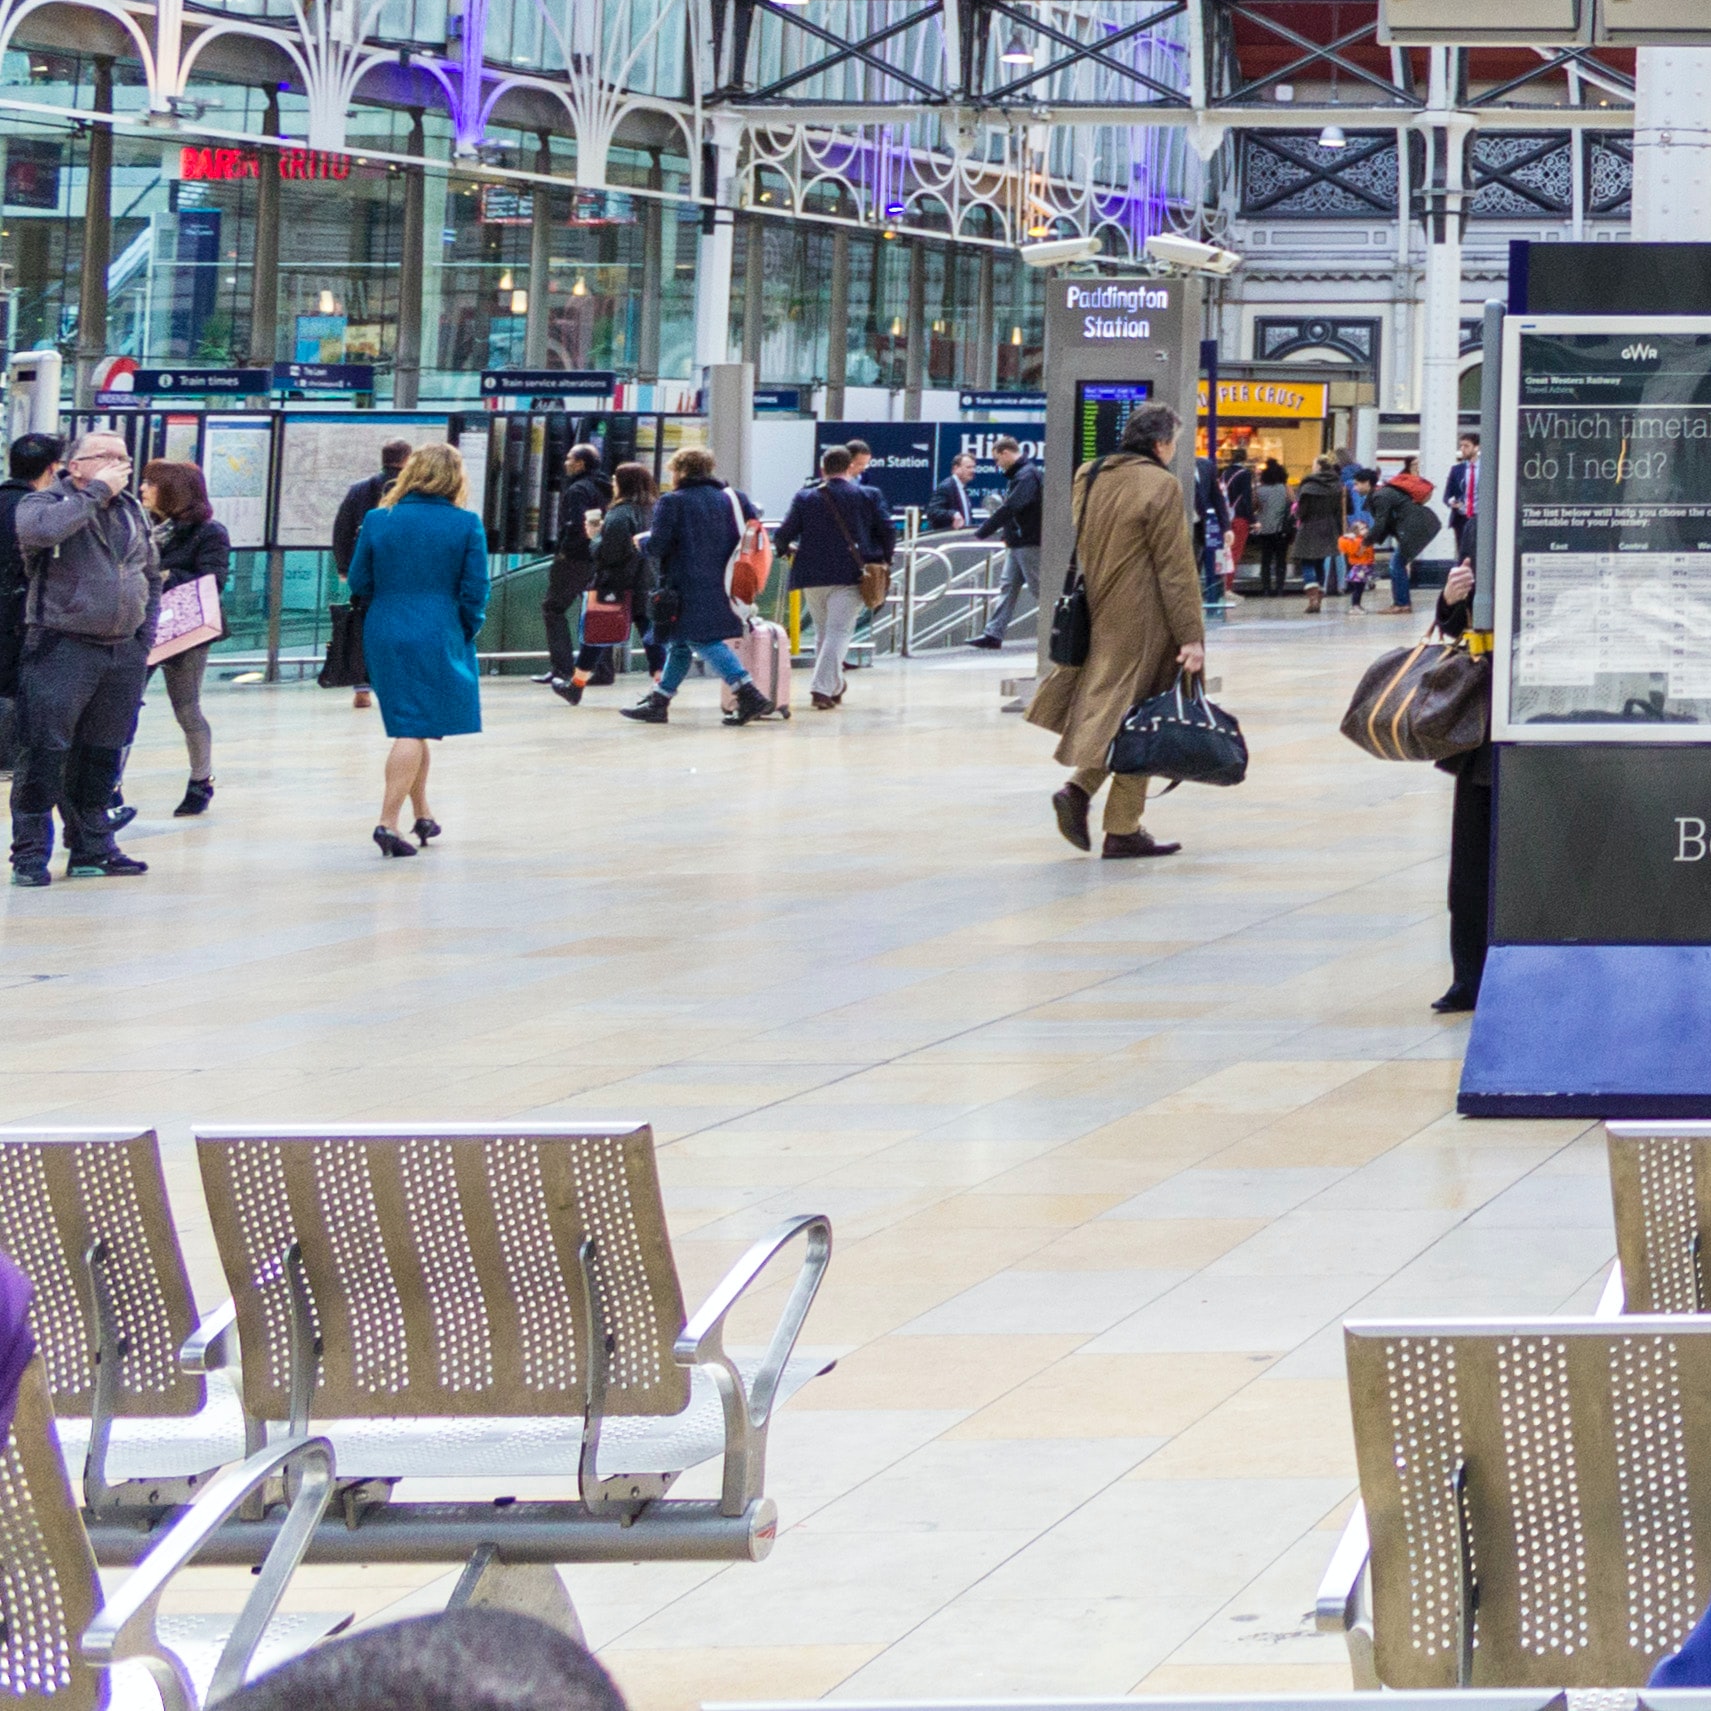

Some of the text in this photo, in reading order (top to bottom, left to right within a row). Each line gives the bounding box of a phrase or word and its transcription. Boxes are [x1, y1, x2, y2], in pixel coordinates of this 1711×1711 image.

[1067, 286, 1168, 314] Paddington
[1083, 316, 1150, 338] Station
[1621, 343, 1657, 361] GWR
[208, 376, 239, 386] times
[525, 379, 557, 387] service
[1525, 376, 1621, 386] Great Western Railway
[1255, 385, 1304, 410] CRUST
[1525, 411, 1610, 439] Which
[887, 456, 928, 468] Station
[1524, 453, 1667, 479] do I need?
[1523, 509, 1542, 517] The
[1561, 509, 1592, 517] below
[1594, 509, 1613, 517] will
[1615, 509, 1635, 519] help
[1638, 510, 1657, 519] you
[1689, 509, 1705, 517] the
[1571, 518, 1585, 526] for
